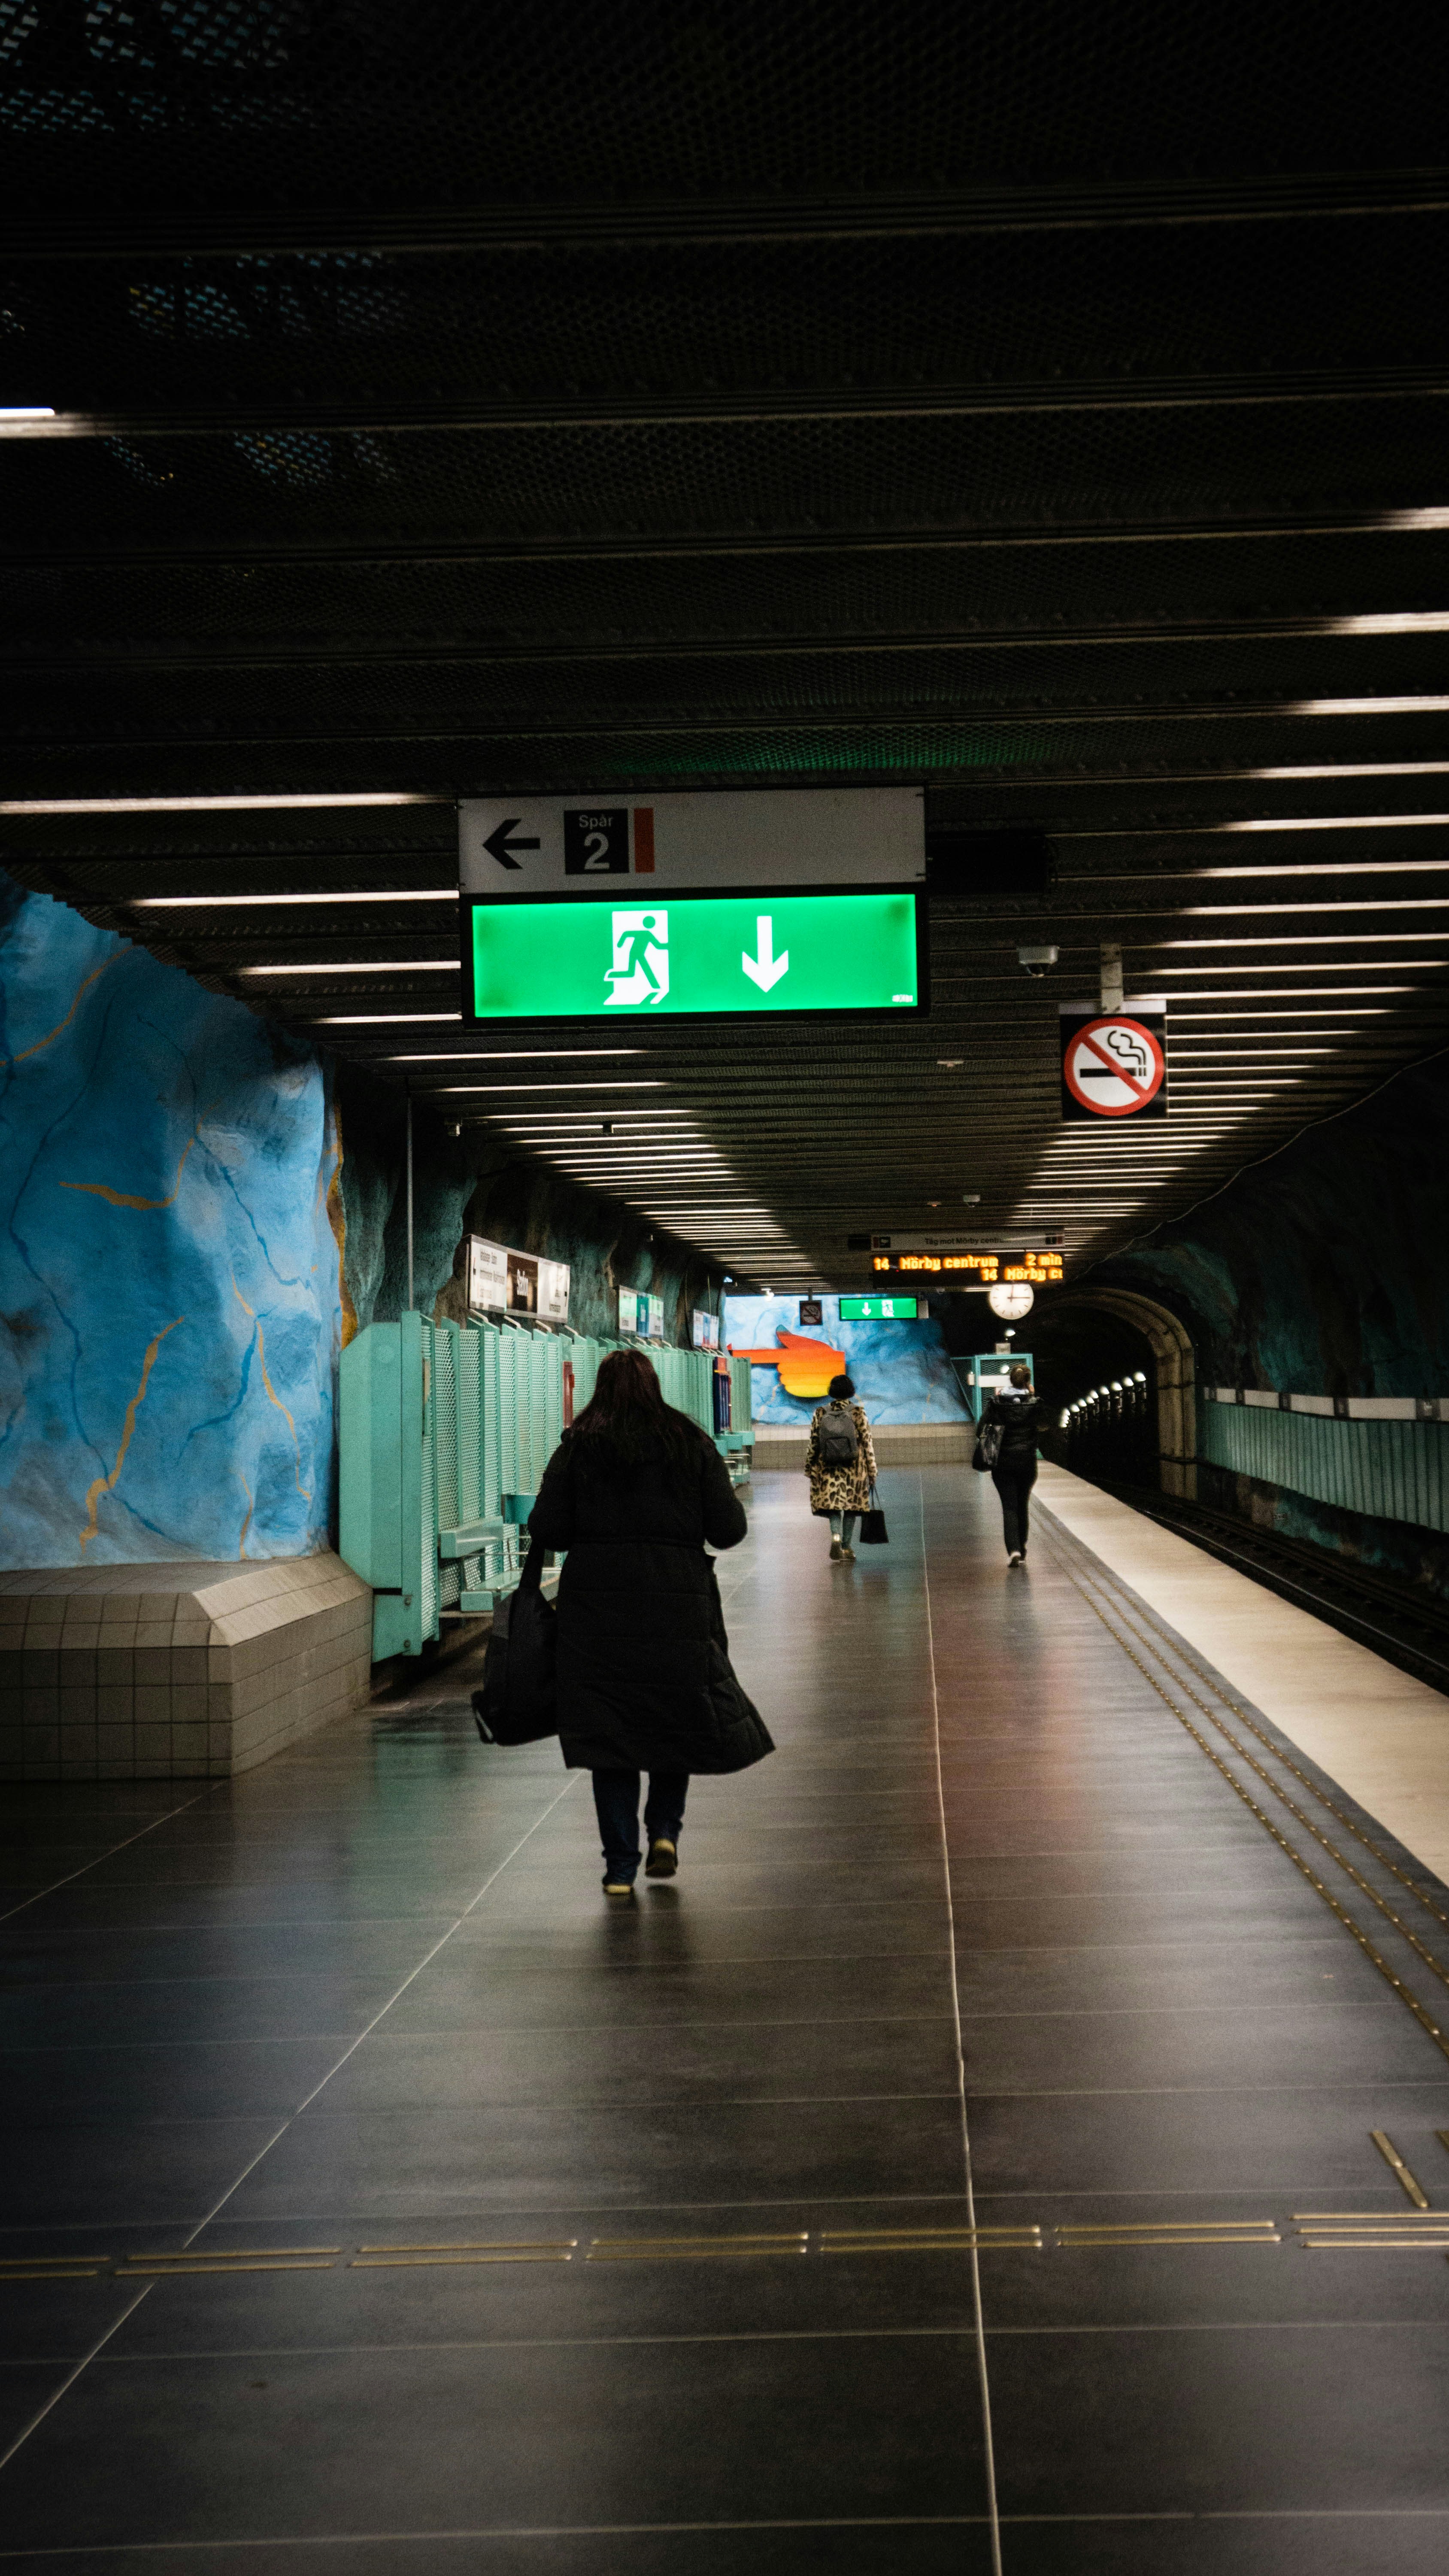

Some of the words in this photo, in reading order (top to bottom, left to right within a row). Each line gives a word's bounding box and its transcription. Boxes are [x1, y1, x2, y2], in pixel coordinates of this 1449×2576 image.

[579, 814, 613, 829] Spår
[584, 832, 610, 870] 2
[873, 1257, 890, 1270] 14
[899, 1255, 942, 1271] Mörby
[943, 1255, 999, 1269] centrum
[1025, 1252, 1037, 1266] 2
[1037, 1252, 1063, 1266] min
[981, 1267, 998, 1281] 14
[1004, 1266, 1046, 1282] Mörby
